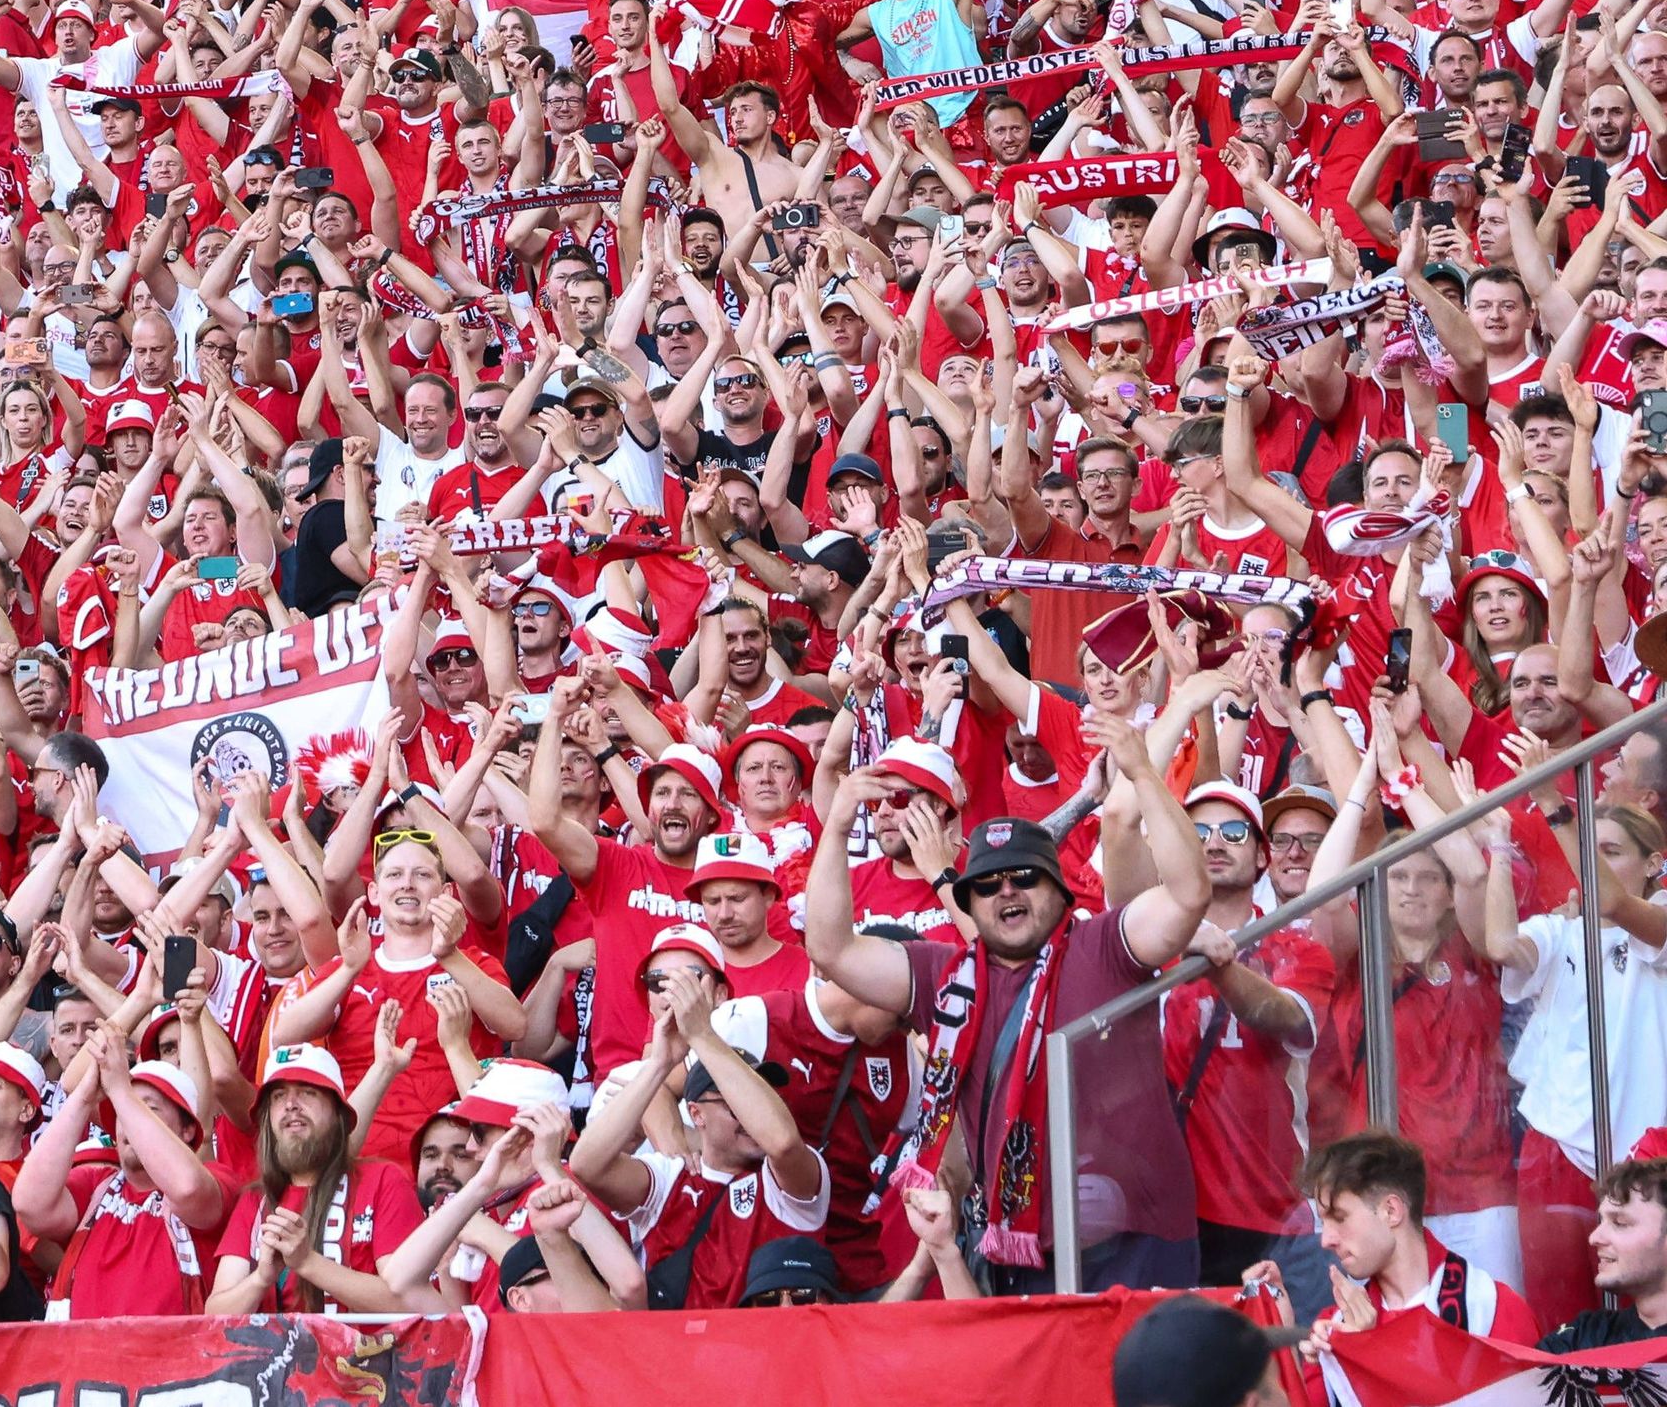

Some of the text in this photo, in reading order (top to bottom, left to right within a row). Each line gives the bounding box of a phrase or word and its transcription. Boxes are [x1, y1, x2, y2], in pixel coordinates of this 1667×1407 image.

[926, 60, 1021, 94] WIEDER
[601, 100, 617, 123] 21
[1025, 156, 1201, 195] AUSTRI
[201, 722, 220, 747] DER
